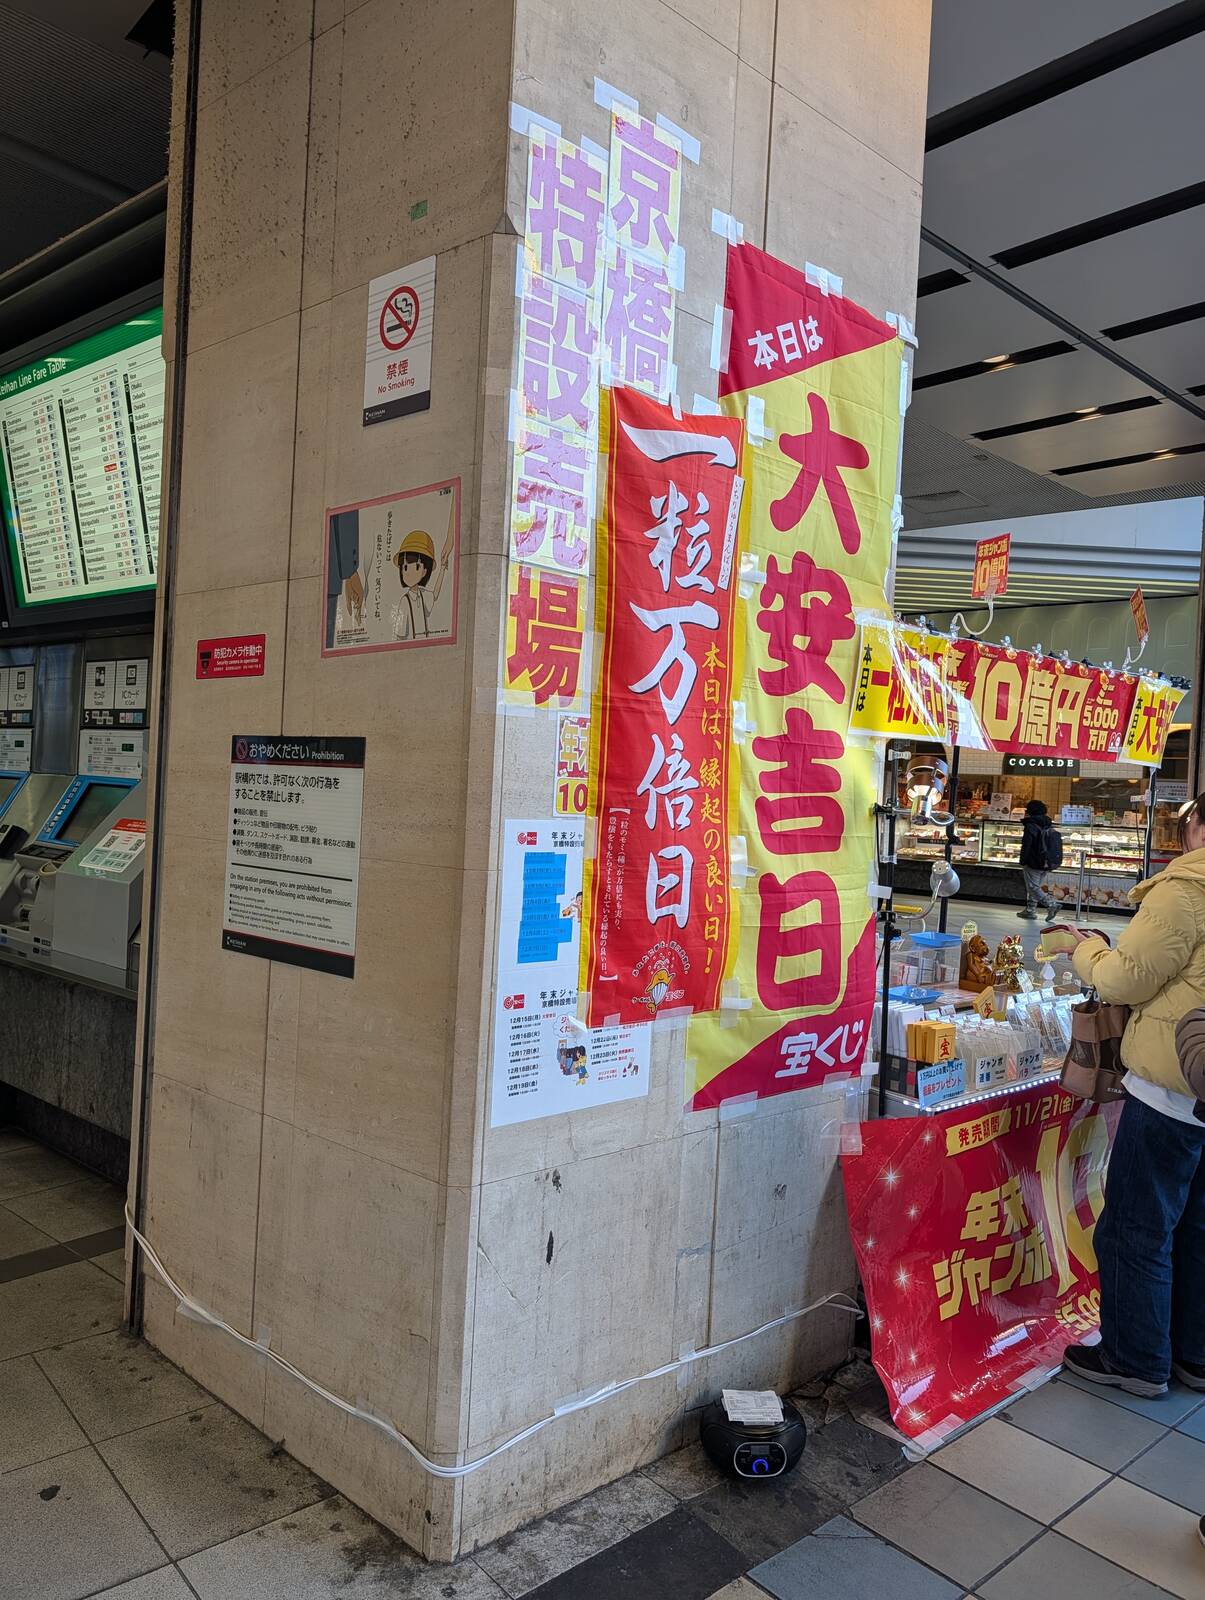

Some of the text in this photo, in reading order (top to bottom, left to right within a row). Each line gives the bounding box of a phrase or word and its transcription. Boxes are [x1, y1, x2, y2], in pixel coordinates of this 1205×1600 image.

[747, 314, 825, 370] 本日は
[0, 358, 67, 396] eihan Line Fare Table
[386, 358, 410, 381] 禁煙
[377, 376, 416, 395] No Smoking
[214, 644, 263, 660] 防犯カメラ作動中
[619, 417, 739, 929] 一粒万倍日
[856, 643, 873, 712] 本日は
[755, 391, 870, 1012] 大安吉日
[971, 656, 1095, 751] 10億円
[84, 711, 90, 723] 5
[1126, 695, 1144, 746] 本日は
[248, 743, 310, 759] おやめください
[1087, 728, 1109, 752] 万円
[311, 751, 345, 761] Prohibition
[1008, 758, 1074, 768] COCARDE
[235, 772, 341, 790] 駅構内では、許可なく次の行為を
[234, 788, 305, 804] することを禁止します。
[559, 783, 588, 813] 10
[774, 1017, 864, 1080] 宝くじ
[939, 1037, 951, 1058] 宝
[1019, 1052, 1040, 1066] ジャンボ
[980, 1056, 1004, 1070] ジャンボ
[958, 1094, 1075, 1148] 発売期間 11/21(金)
[959, 1174, 1030, 1242] 年末
[932, 1220, 1053, 1322] ジャンボ
